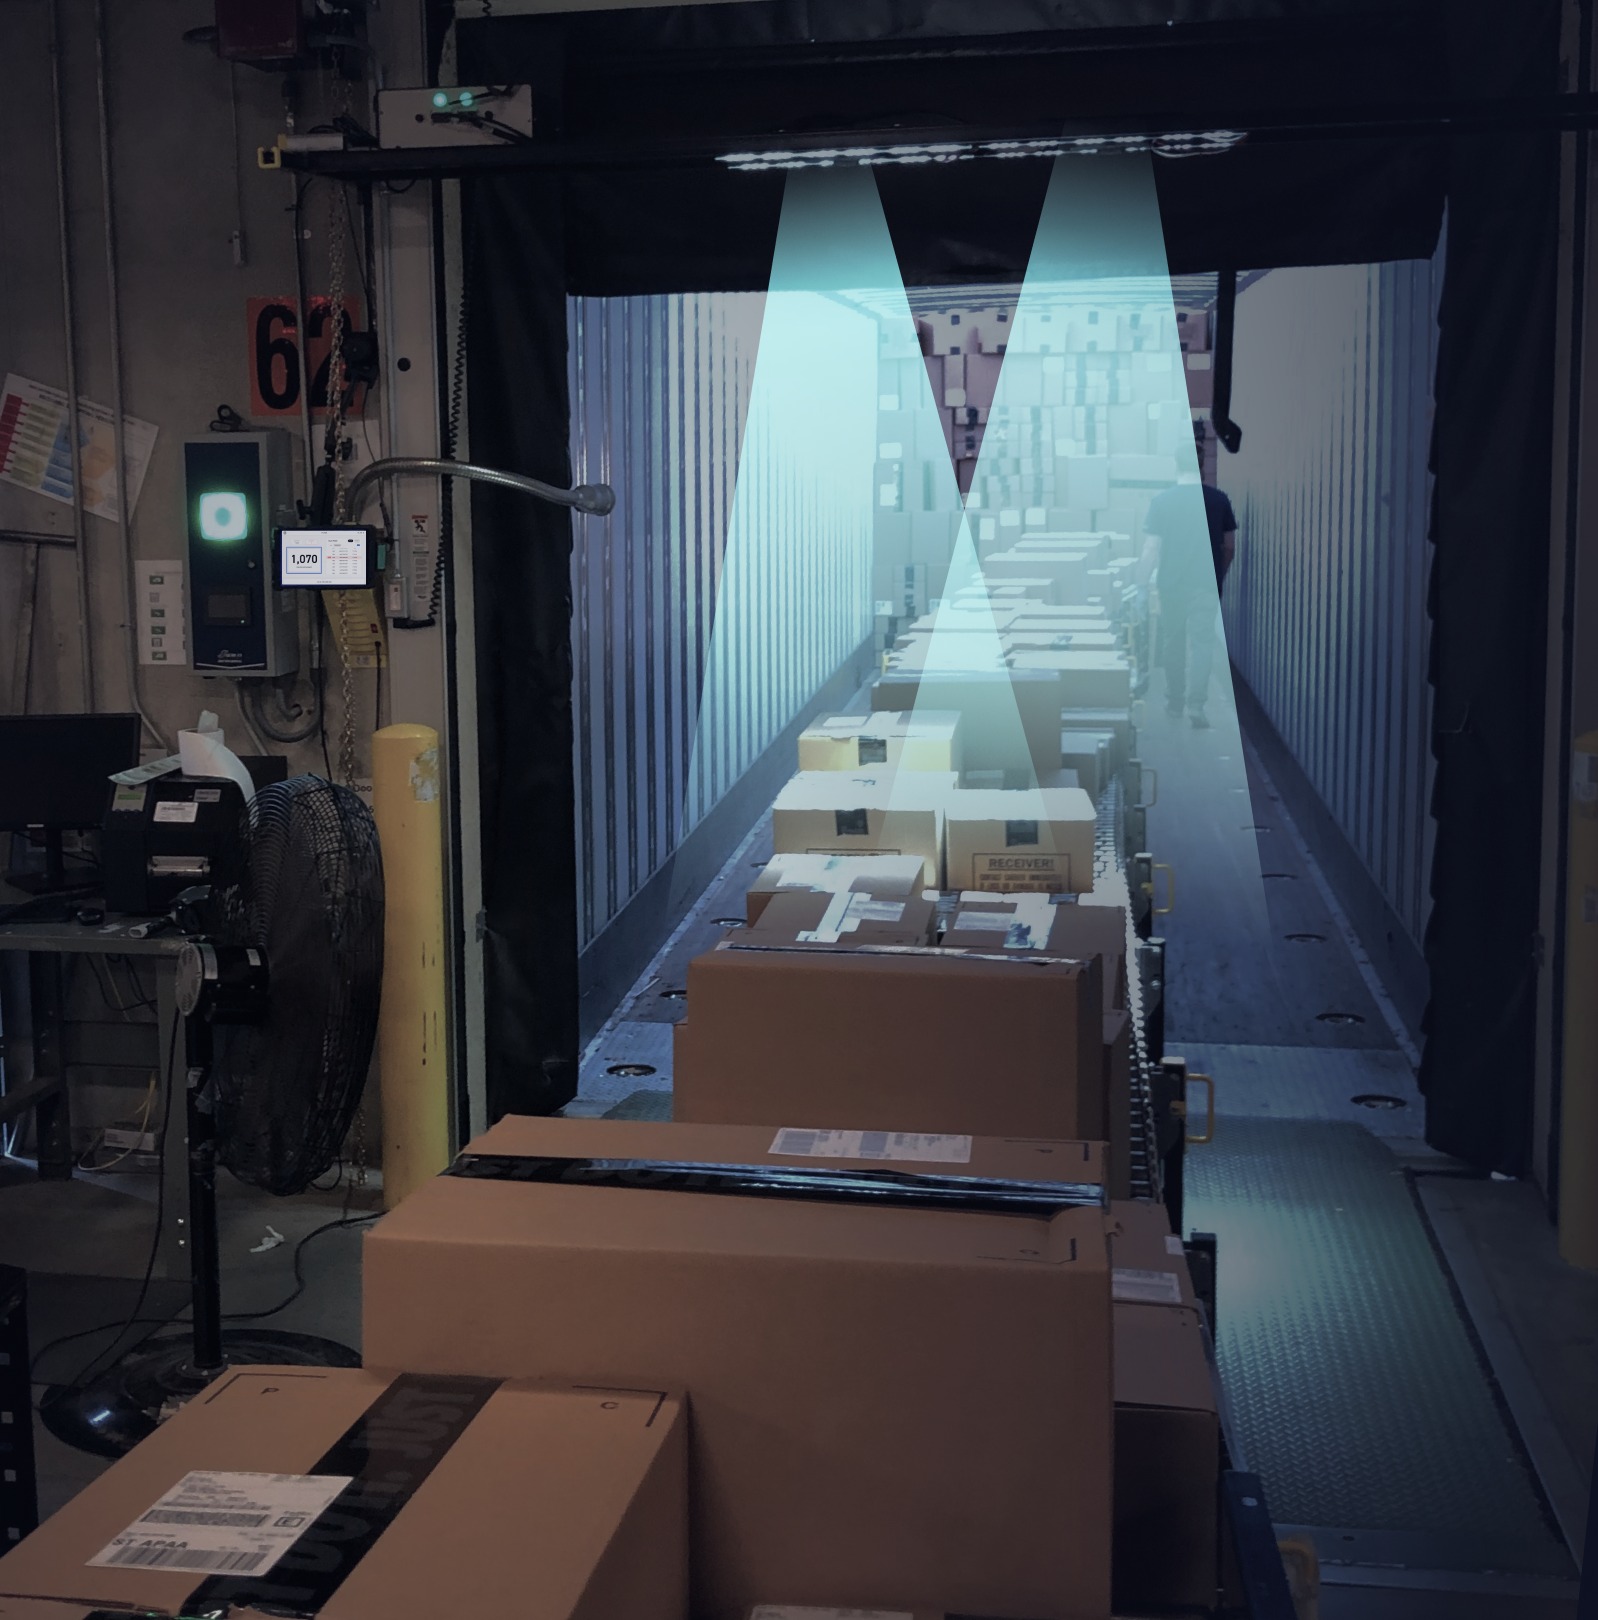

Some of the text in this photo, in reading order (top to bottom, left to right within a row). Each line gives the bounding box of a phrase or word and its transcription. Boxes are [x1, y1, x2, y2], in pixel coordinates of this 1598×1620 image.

[256, 304, 354, 410] 62
[291, 554, 318, 565] 1,070
[988, 858, 1054, 868] RECEIVER!
[600, 1401, 619, 1410] C
[349, 1387, 476, 1464] JUST
[112, 1538, 137, 1546] ST
